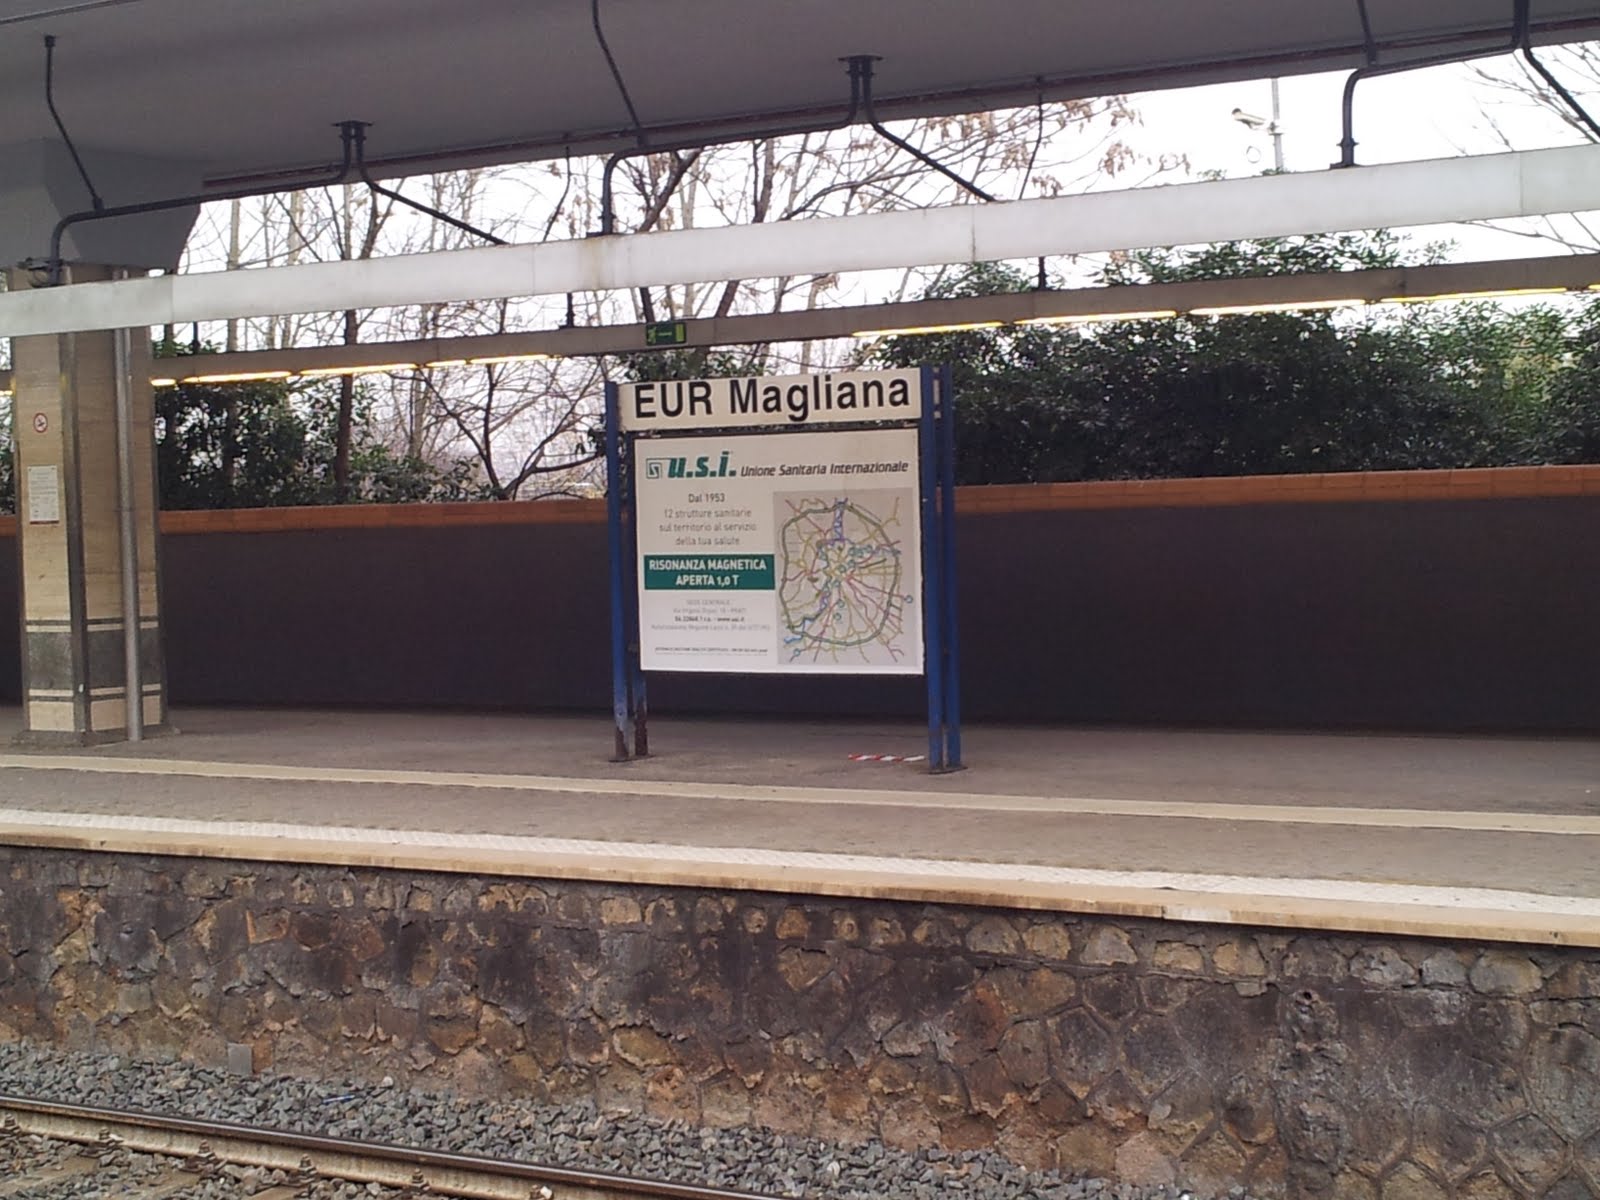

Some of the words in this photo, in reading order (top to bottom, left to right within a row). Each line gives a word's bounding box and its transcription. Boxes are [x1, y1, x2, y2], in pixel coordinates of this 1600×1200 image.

[635, 380, 713, 419] EUR
[730, 375, 910, 422] Magliana
[668, 451, 737, 479] u.s.i.
[741, 465, 775, 478] Unione
[779, 463, 827, 477] Sanitaria
[830, 460, 909, 476] Internazionale
[688, 493, 703, 503] Dal
[706, 492, 725, 503] 1953
[664, 509, 673, 519] 12
[675, 509, 711, 519] strutture
[714, 509, 752, 518] sanitarie
[659, 523, 671, 532] sul
[673, 523, 712, 532] territorio
[714, 522, 722, 531] al
[724, 523, 757, 531] servizio
[675, 537, 696, 546] della
[698, 537, 712, 546] tua
[714, 537, 740, 546] salute
[649, 559, 706, 571] RISONANZA
[707, 558, 767, 570] MAGNETICA
[675, 574, 715, 586] APERTA
[716, 575, 731, 587] 1,0
[731, 574, 740, 585] T
